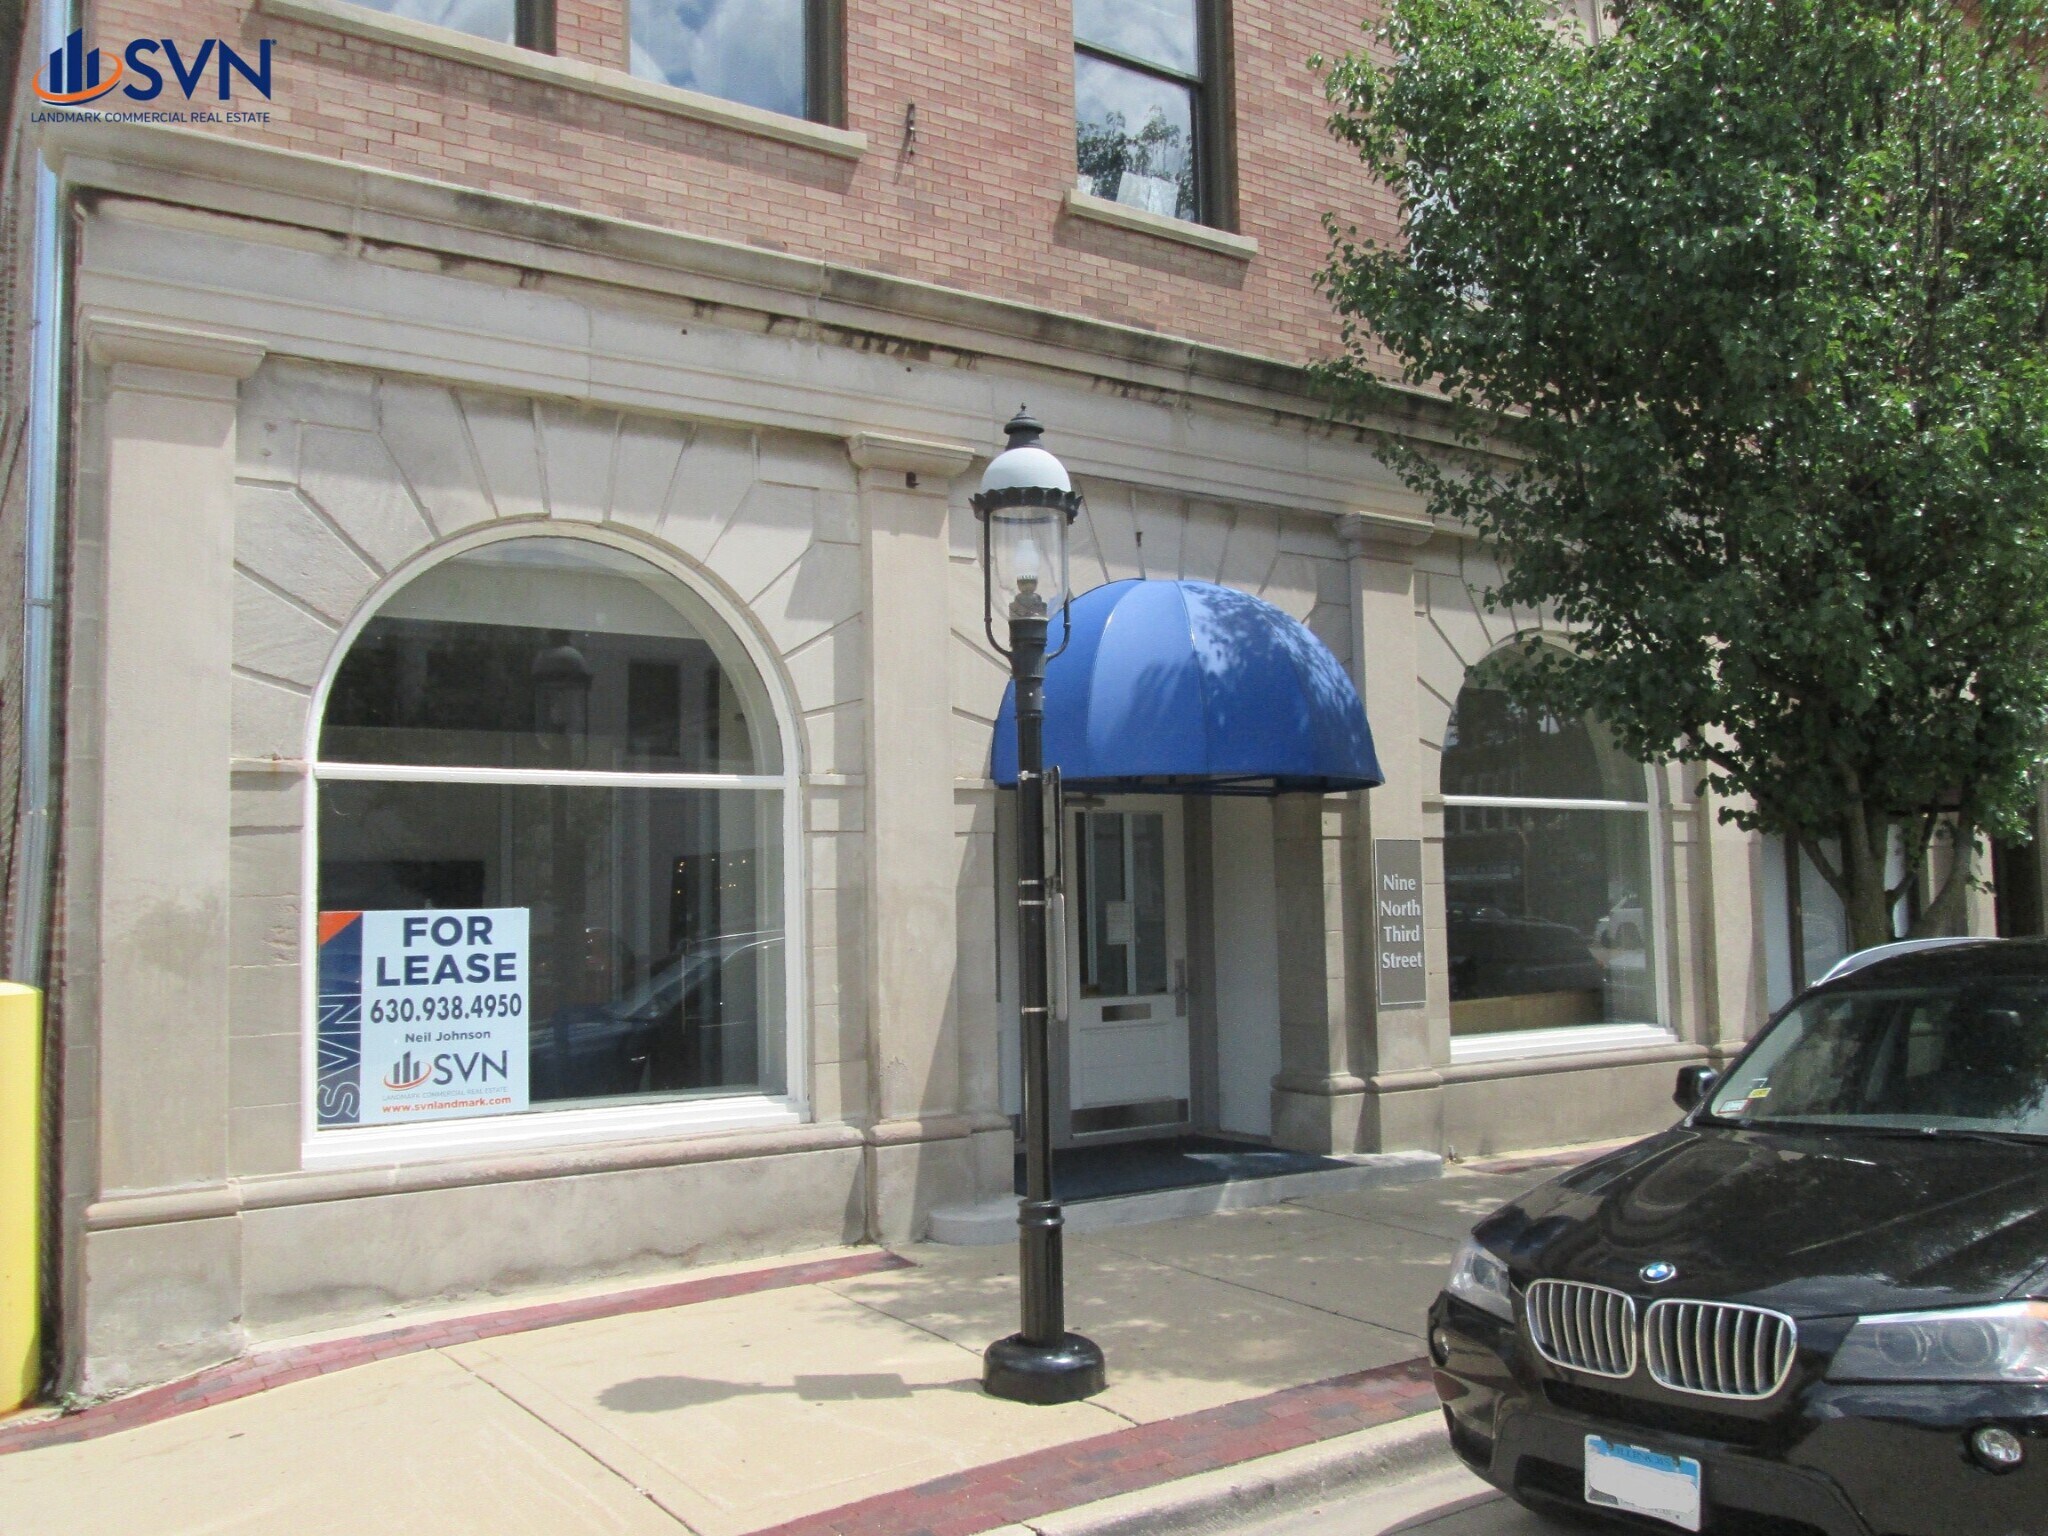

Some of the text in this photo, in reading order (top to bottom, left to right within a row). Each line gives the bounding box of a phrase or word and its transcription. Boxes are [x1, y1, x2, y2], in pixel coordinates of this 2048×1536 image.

[1383, 874, 1416, 891] Nine
[1380, 899, 1421, 917] North
[402, 916, 493, 948] FOR
[1383, 925, 1420, 942] Third
[376, 952, 517, 987] LEASE
[1382, 952, 1423, 969] Street
[369, 993, 522, 1025] 630.938.4950
[404, 1030, 491, 1043] Neil Johnson
[432, 1050, 508, 1086] SVN
[382, 1096, 512, 1114] www.svnlandmark.com
